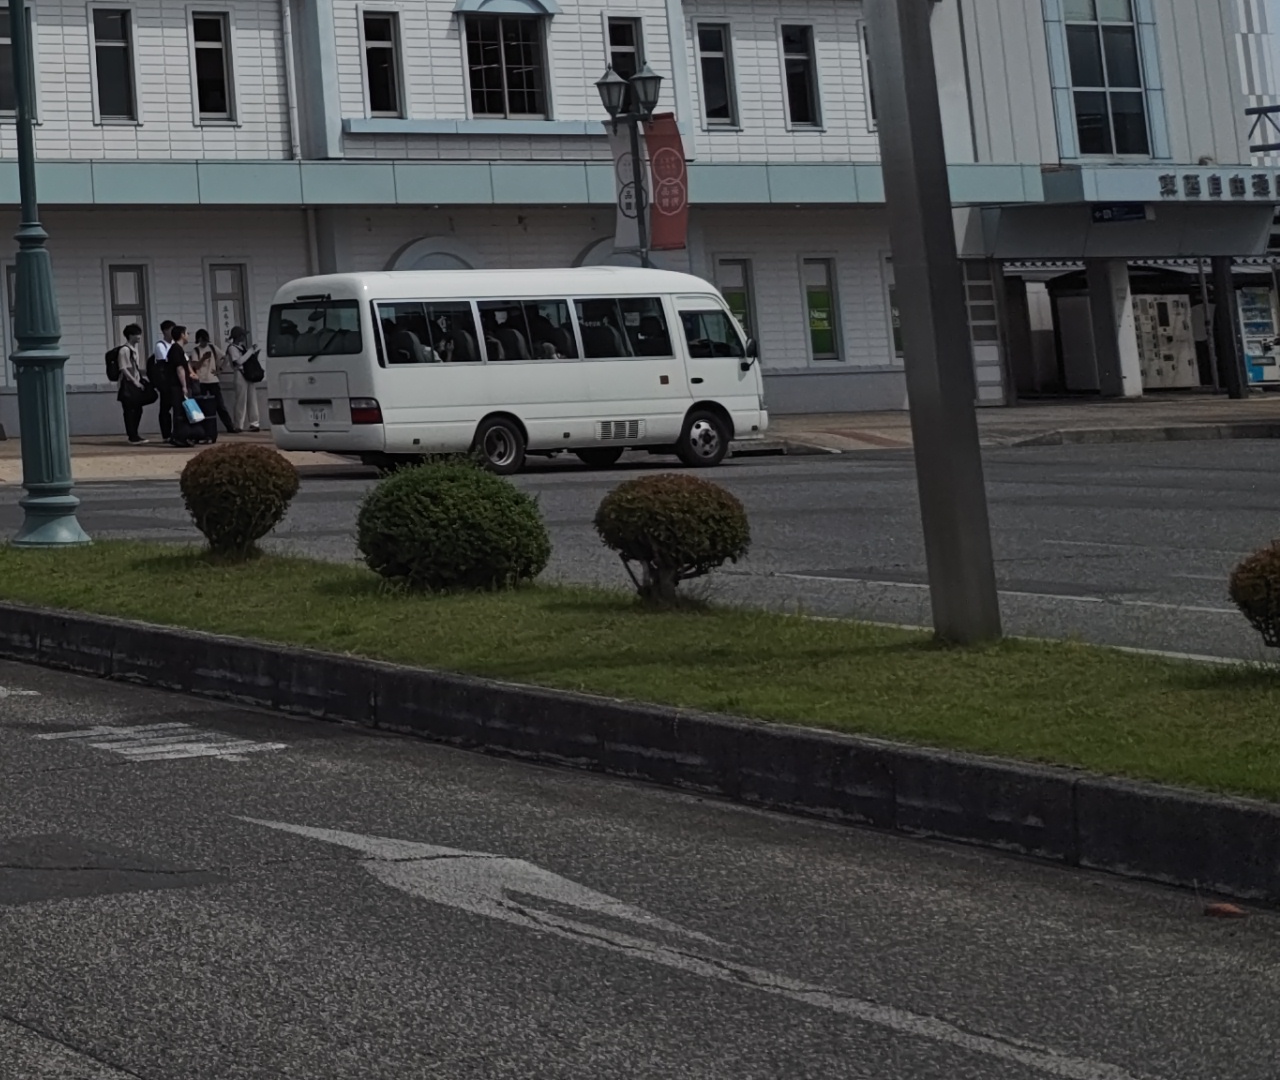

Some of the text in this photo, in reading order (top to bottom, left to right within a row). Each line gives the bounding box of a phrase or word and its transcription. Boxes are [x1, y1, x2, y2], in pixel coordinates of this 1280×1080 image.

[1158, 173, 1280, 198] 東西自由通
